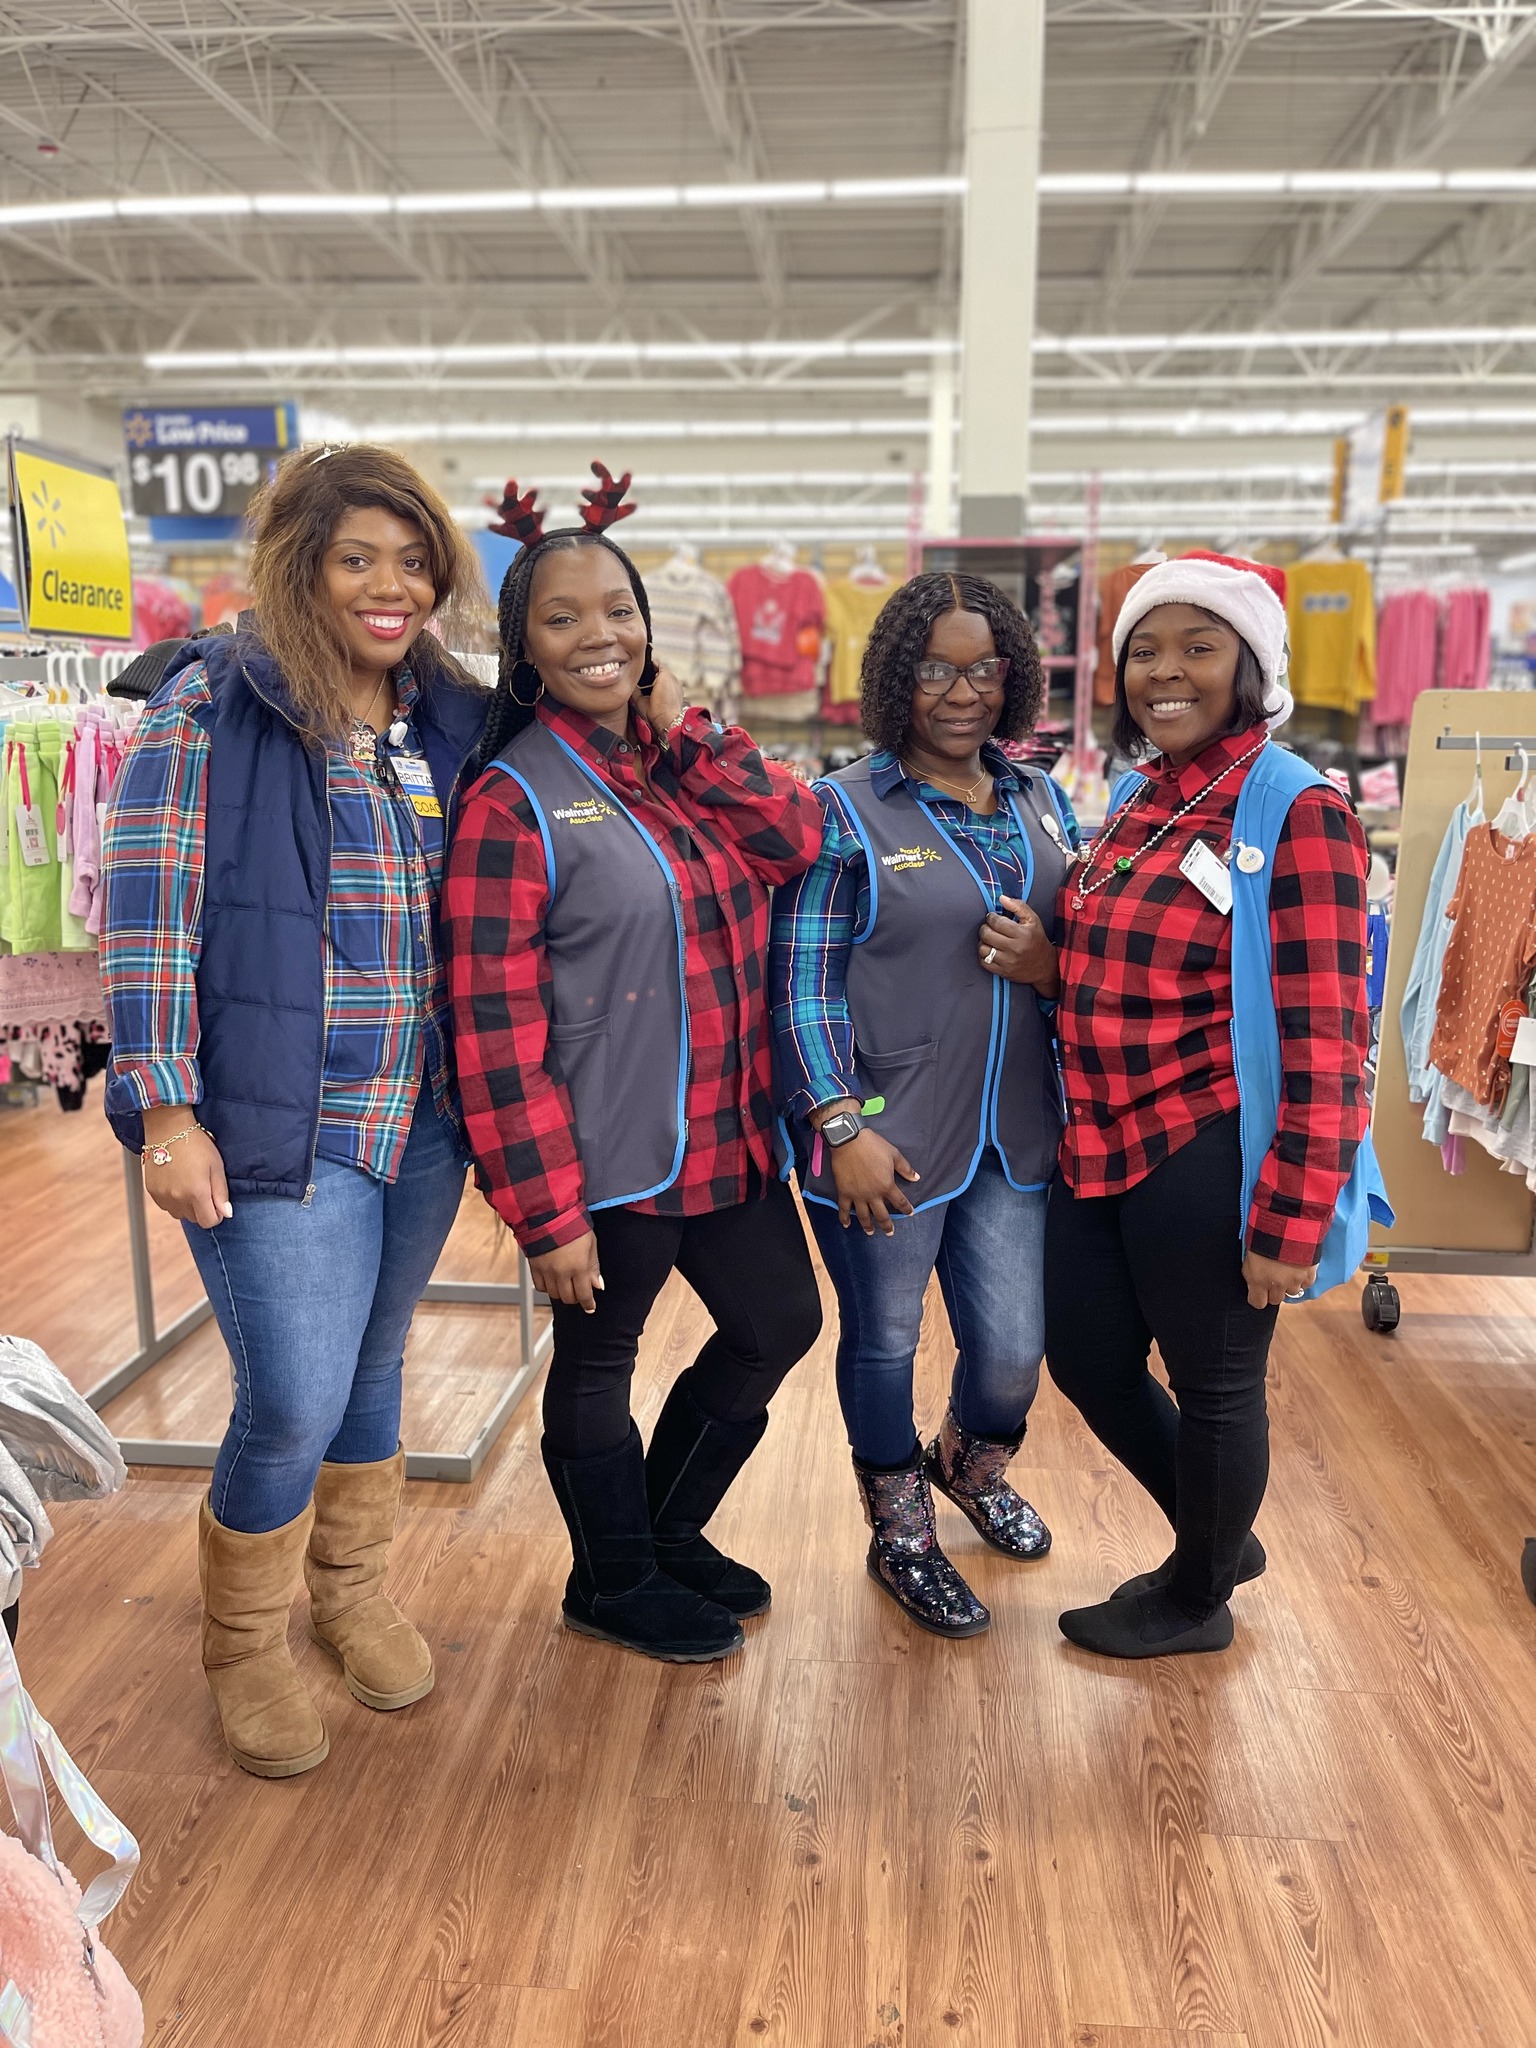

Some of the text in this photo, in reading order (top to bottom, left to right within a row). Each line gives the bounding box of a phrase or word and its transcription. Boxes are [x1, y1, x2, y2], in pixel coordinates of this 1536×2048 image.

[42, 569, 124, 612] Clearance
[573, 797, 596, 808] Proud
[552, 806, 600, 820] Walmart
[569, 815, 604, 825] Associate
[899, 845, 921, 854] Proud
[881, 853, 923, 866] Walmart
[893, 860, 926, 873] Associate
